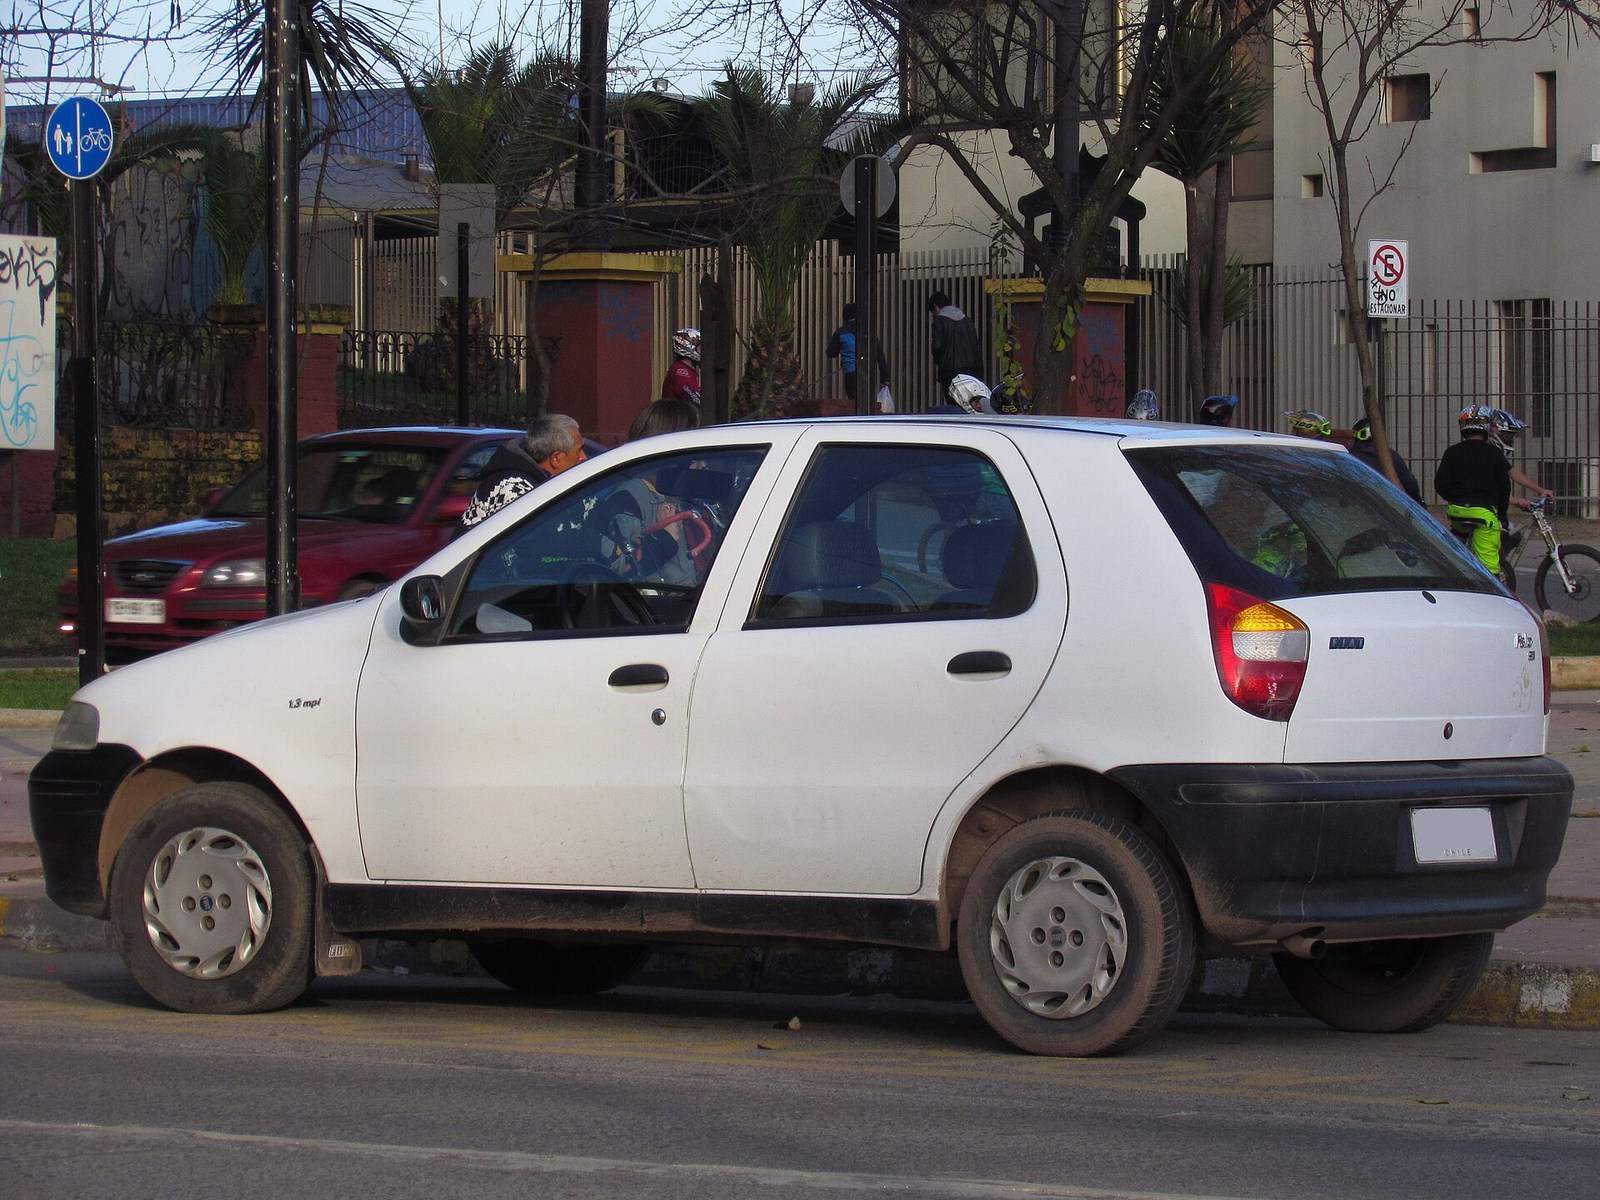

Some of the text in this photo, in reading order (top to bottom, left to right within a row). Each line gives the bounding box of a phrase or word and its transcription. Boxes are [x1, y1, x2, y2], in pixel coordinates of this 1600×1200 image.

[1381, 289, 1396, 302] NO
[1370, 302, 1406, 315] ESTACIONAR
[1331, 637, 1364, 649] FIAT
